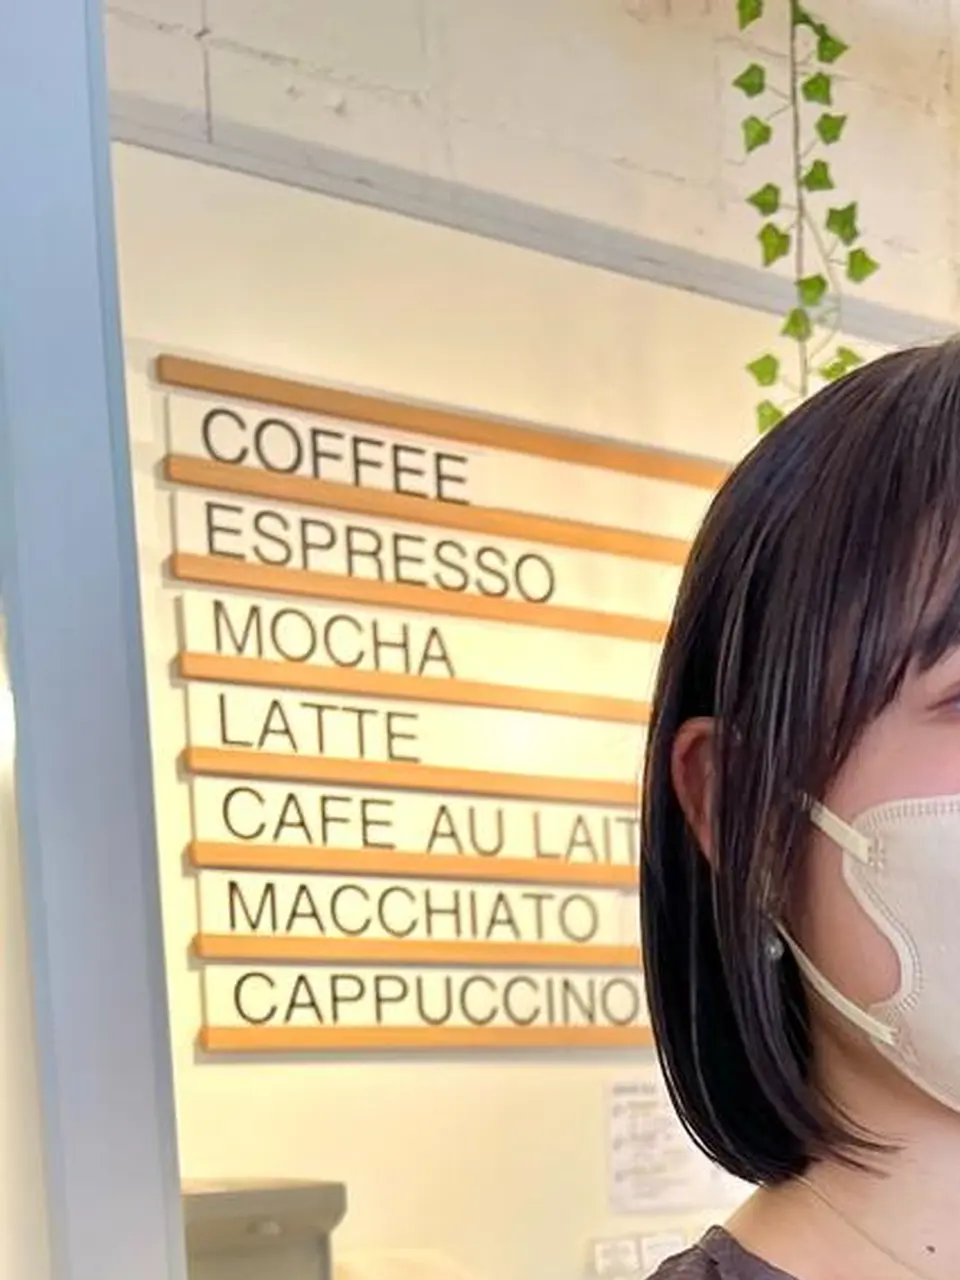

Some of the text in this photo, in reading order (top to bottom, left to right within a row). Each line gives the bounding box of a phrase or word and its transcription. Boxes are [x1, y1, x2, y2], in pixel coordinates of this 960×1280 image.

[202, 408, 470, 506] COFFEE
[205, 502, 556, 604] ESPRESSO
[213, 600, 455, 677] MOCHA
[219, 694, 421, 763] LATTE
[222, 787, 639, 864] CAFE AU LAIT
[228, 881, 599, 942] MACCHIATO
[234, 972, 641, 1026] CAPPUCCINO
